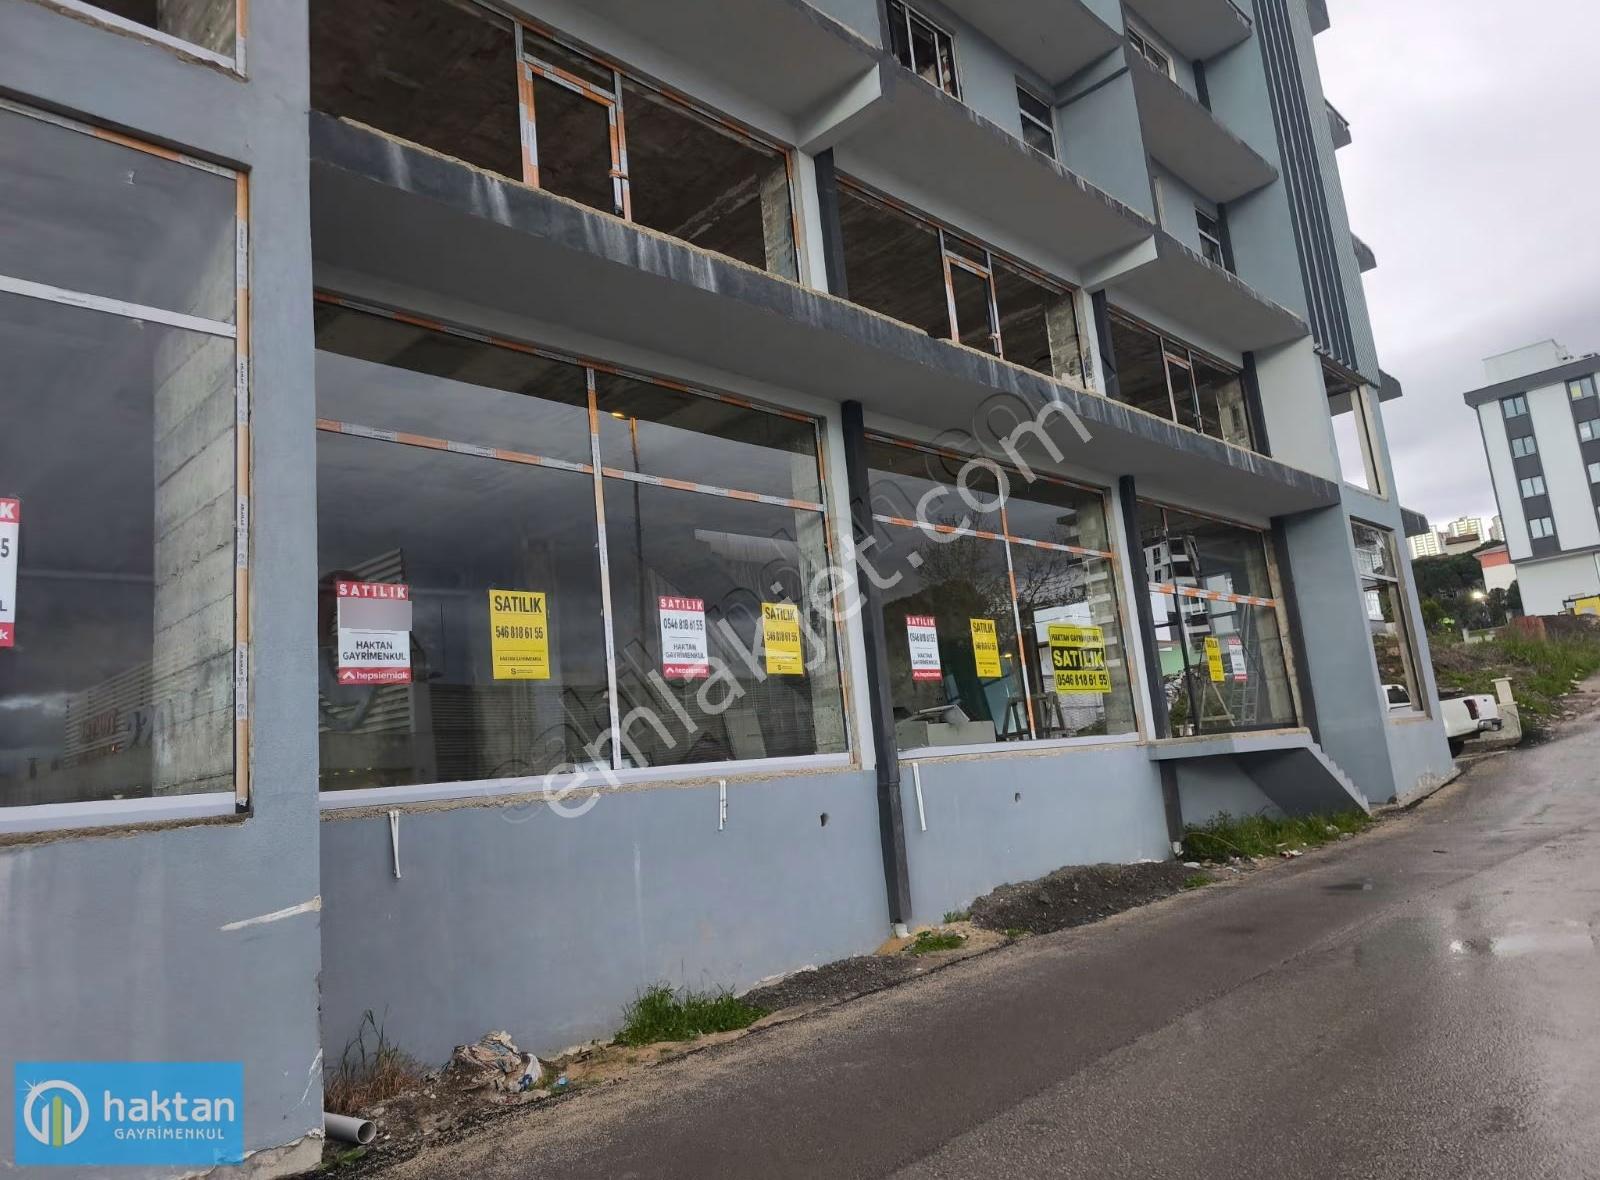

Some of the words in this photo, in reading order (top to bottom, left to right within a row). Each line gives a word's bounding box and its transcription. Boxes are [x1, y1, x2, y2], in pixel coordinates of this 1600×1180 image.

[339, 583, 406, 598] SATILIK
[494, 595, 542, 613] SATILIK
[660, 599, 703, 610] SATILIK
[765, 606, 796, 621] SATILIK
[496, 625, 509, 638] 546
[510, 626, 524, 638] 818
[525, 627, 533, 639] 61
[534, 627, 544, 639] 55
[355, 641, 393, 650] HAKTAN
[342, 650, 406, 661] GAYRİMENKUL
[1053, 650, 1104, 667] SATILIK
[1057, 674, 1073, 685] 0546
[1099, 675, 1107, 685] 55
